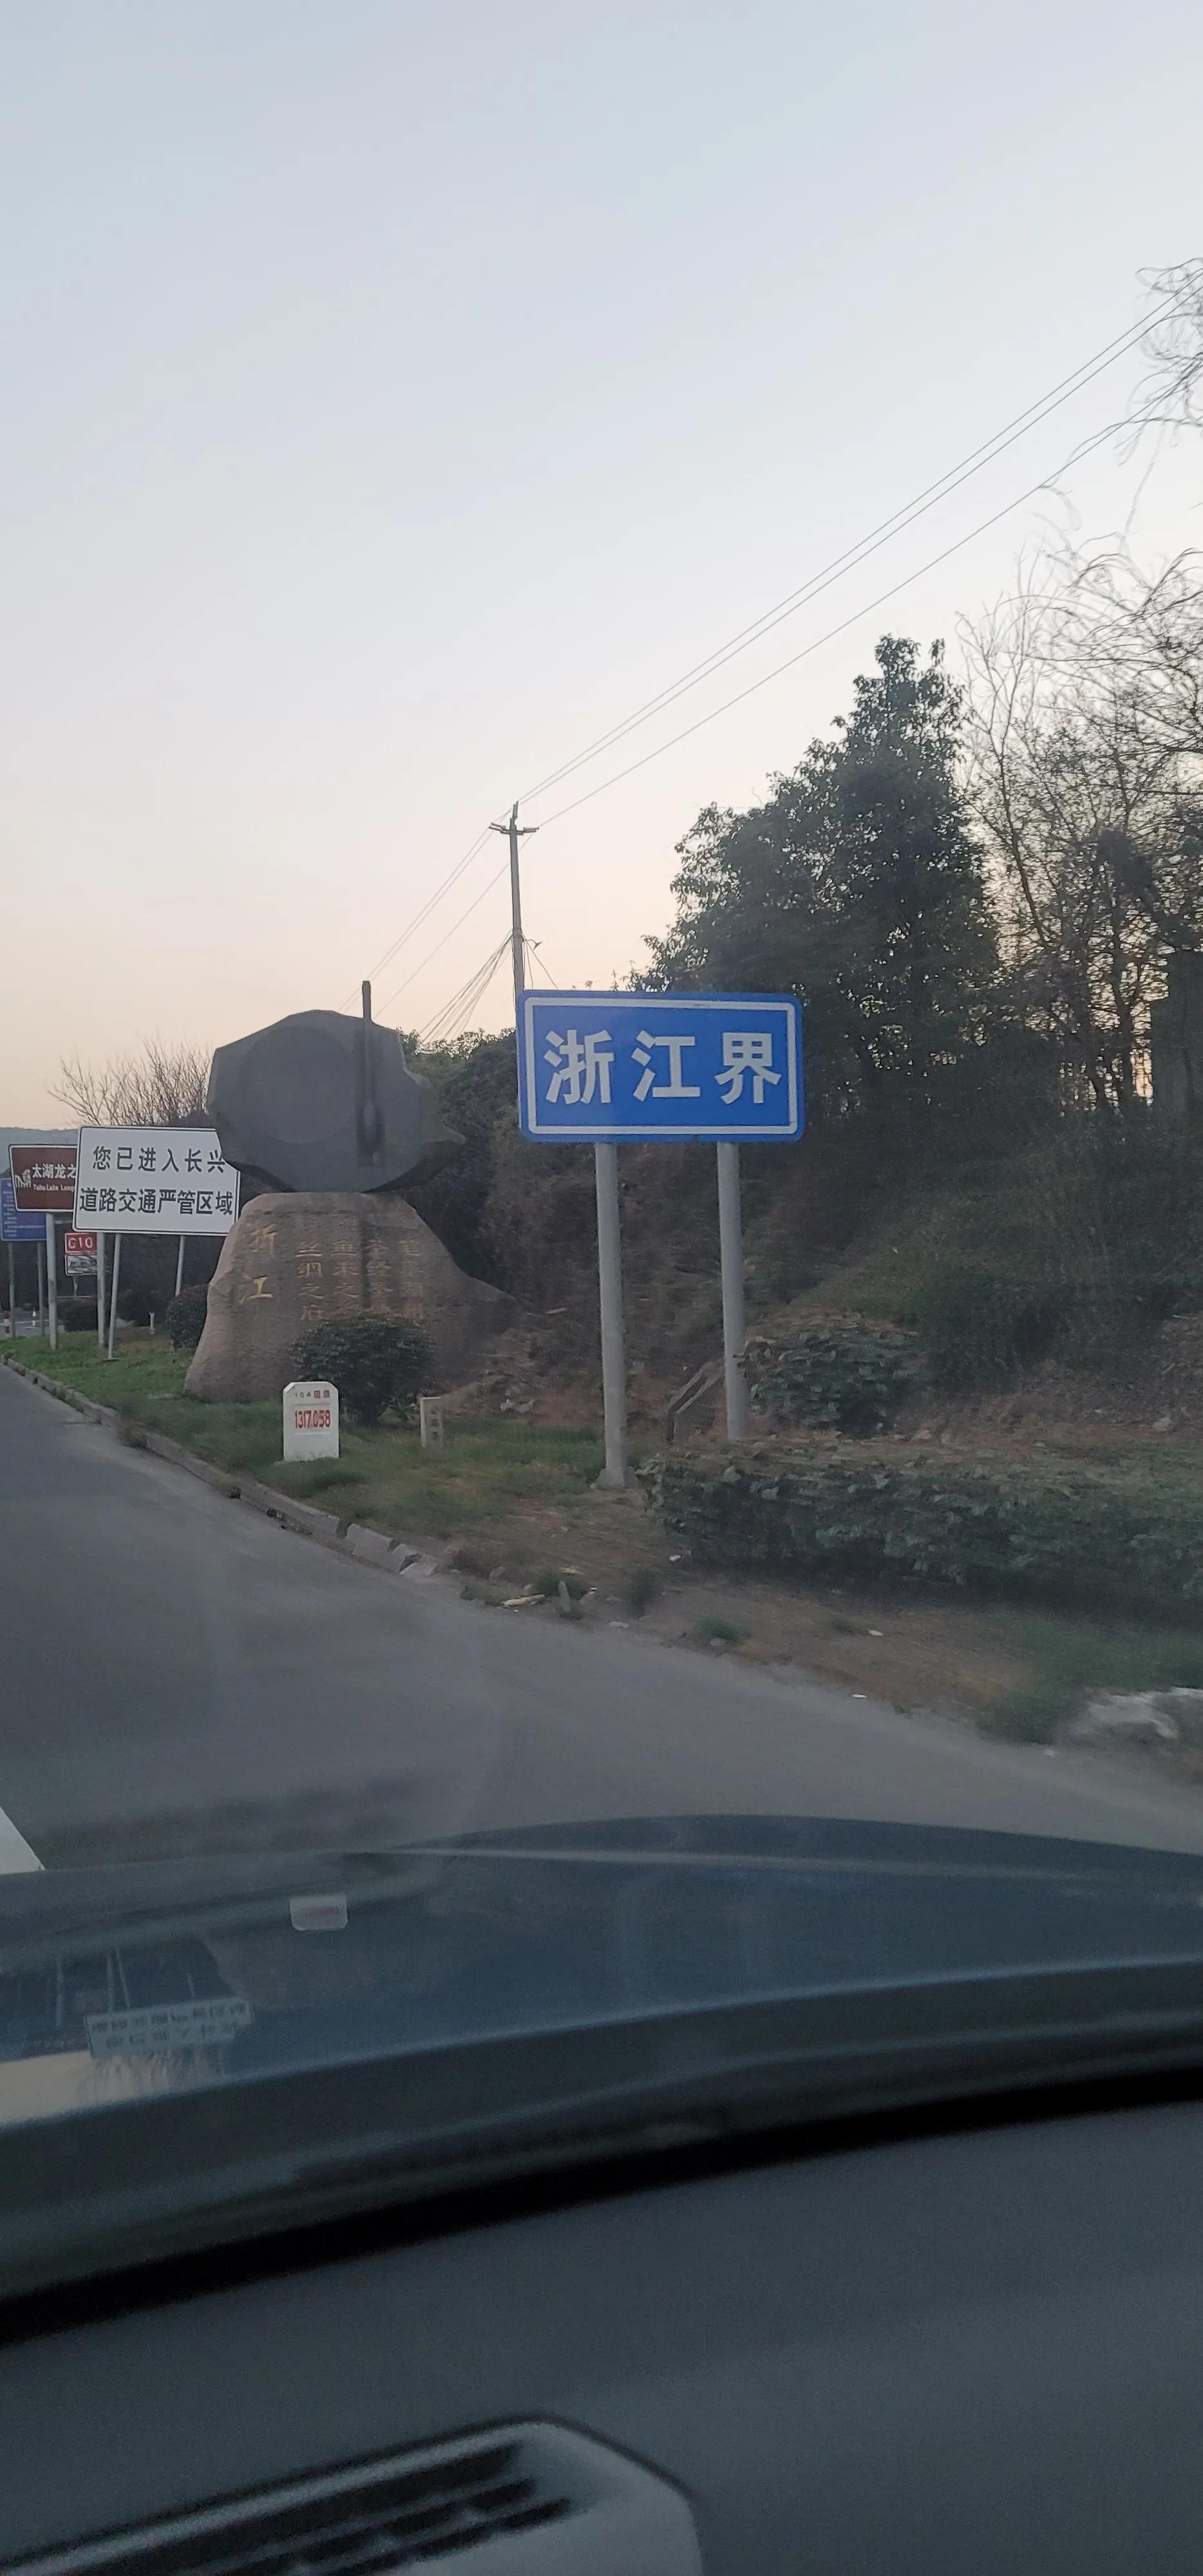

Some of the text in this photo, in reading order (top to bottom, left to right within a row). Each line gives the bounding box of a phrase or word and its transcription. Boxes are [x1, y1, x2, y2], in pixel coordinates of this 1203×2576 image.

[543, 1029, 782, 1104] 浙江界
[92, 1145, 225, 1174] 您已进入长兴
[79, 1188, 233, 1215] 道路交通严管区域
